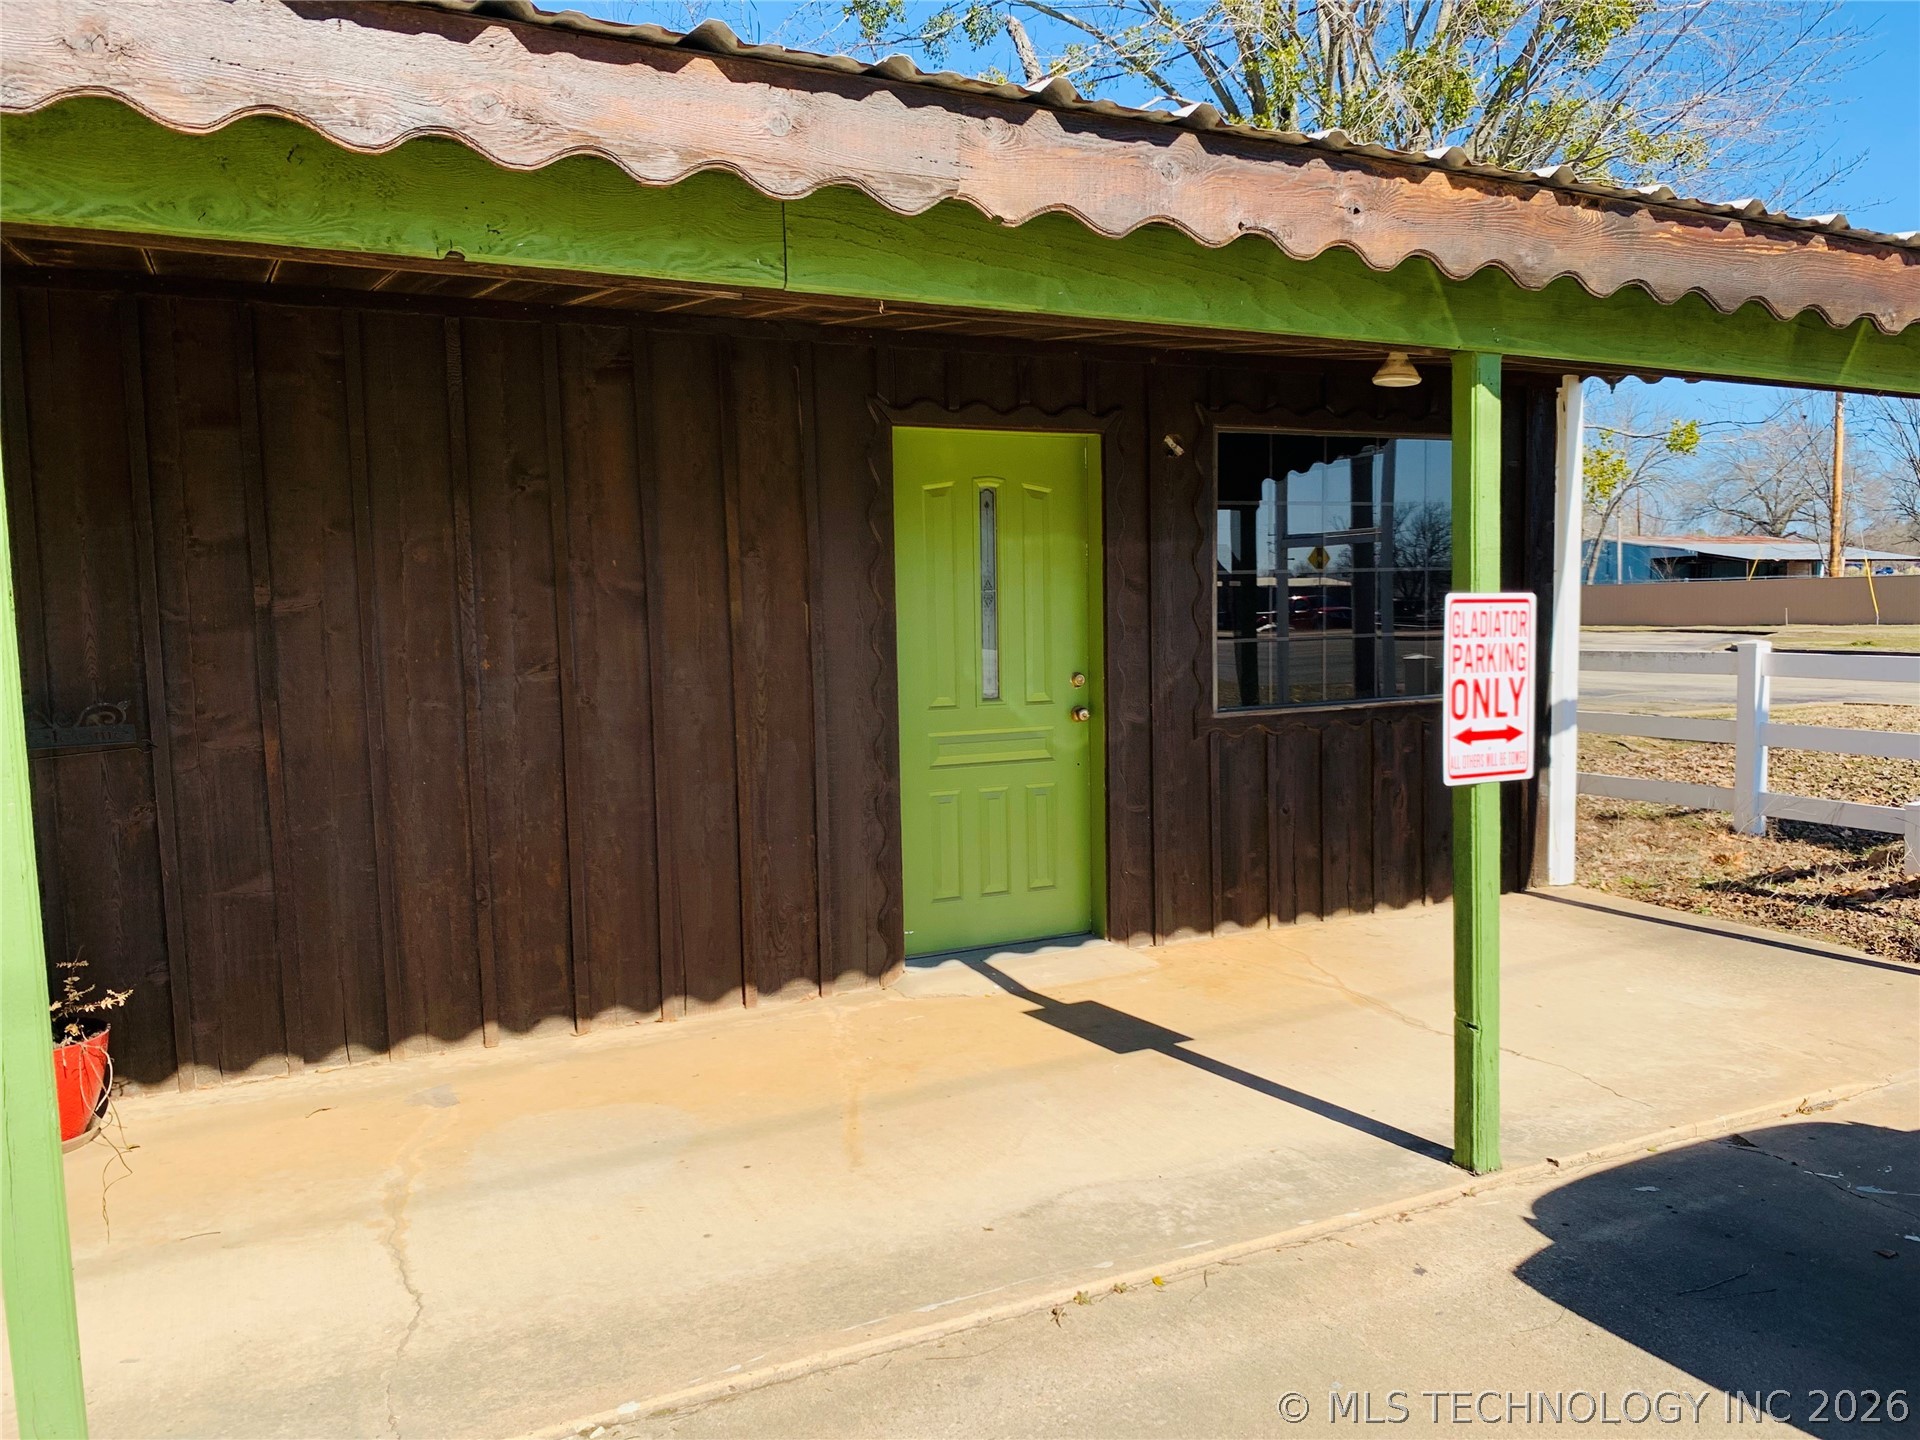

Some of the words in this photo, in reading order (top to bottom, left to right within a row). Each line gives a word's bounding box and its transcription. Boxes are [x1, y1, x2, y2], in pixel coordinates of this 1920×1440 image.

[1452, 610, 1527, 638] GLADIATOR
[1451, 642, 1526, 673] PARKING
[1451, 676, 1526, 721] ONLY
